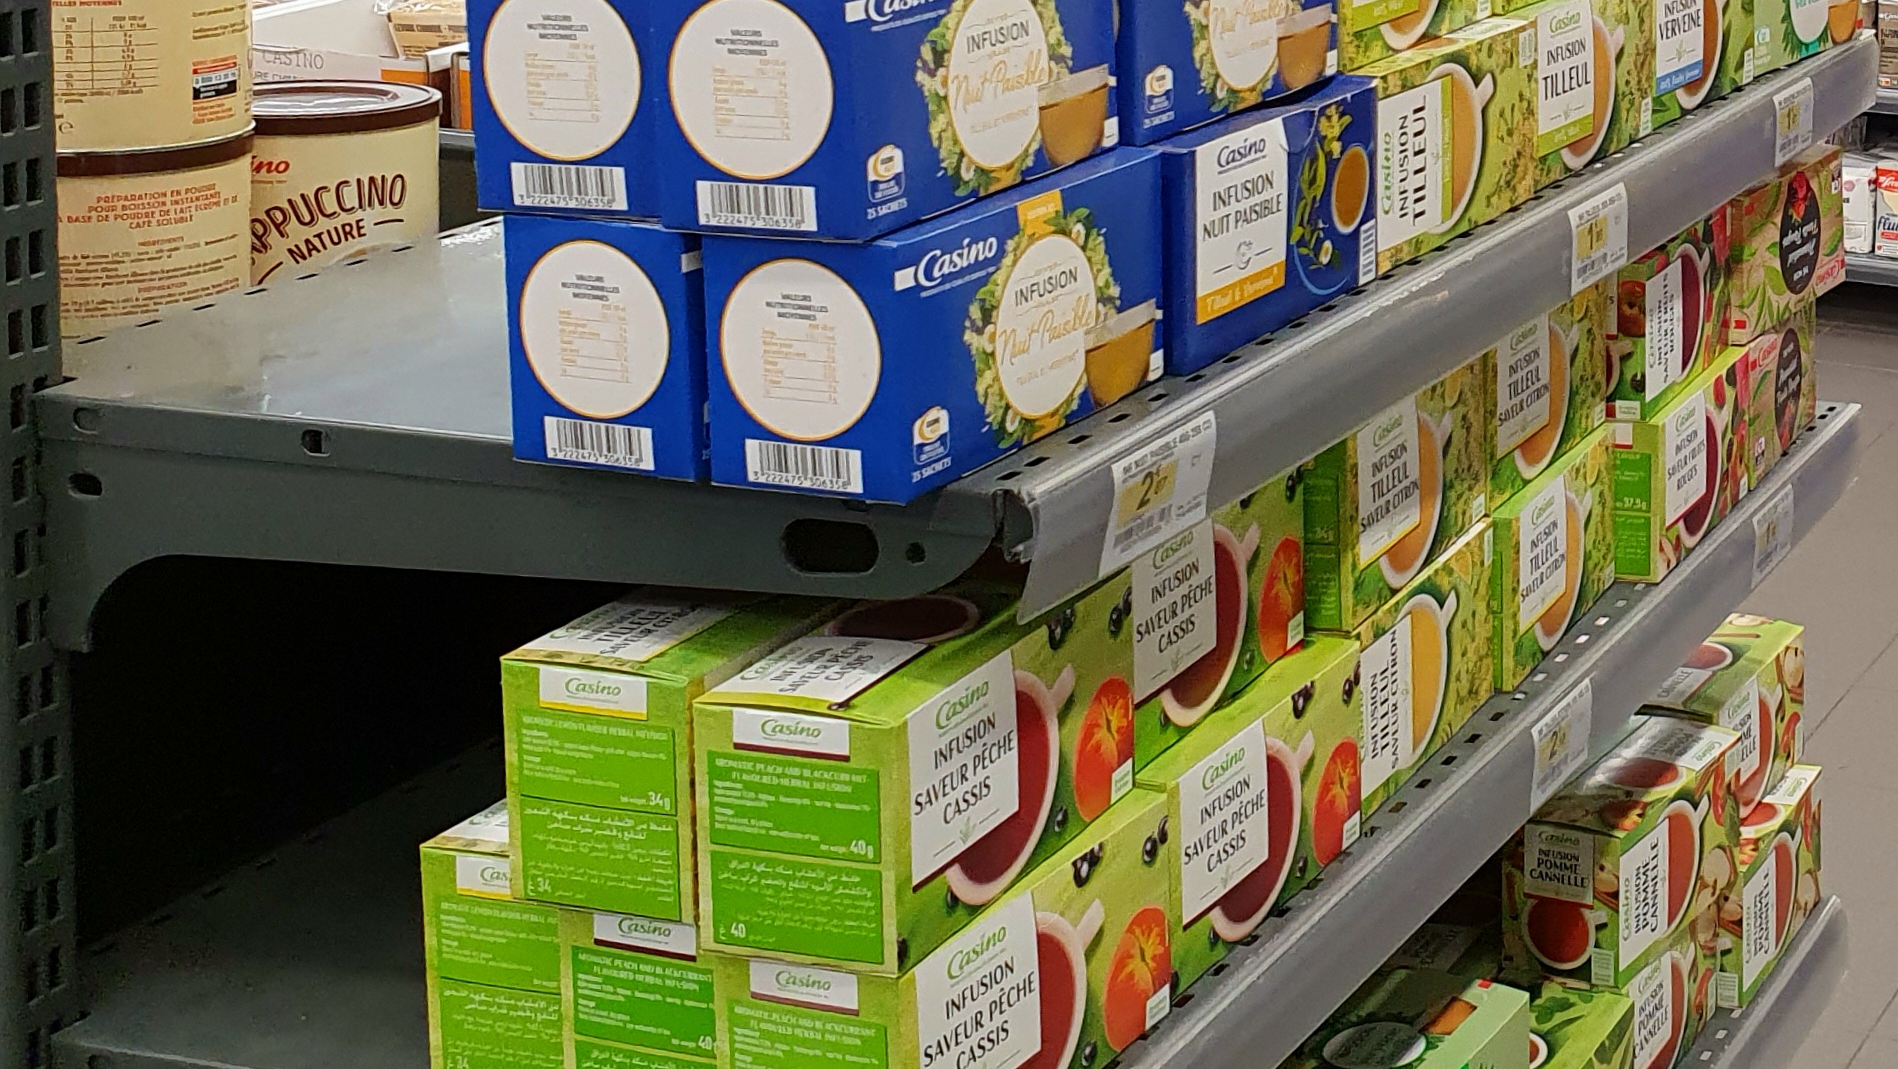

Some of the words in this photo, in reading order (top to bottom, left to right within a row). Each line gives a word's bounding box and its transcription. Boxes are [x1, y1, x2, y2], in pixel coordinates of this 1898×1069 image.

[966, 20, 1030, 54] INFUSION
[1658, 8, 1702, 42] VERVEINE
[262, 52, 325, 71] CASINO
[1546, 36, 1586, 67] INFUSION
[1542, 61, 1591, 102] TILLEUL
[1216, 137, 1266, 168] Casino
[1398, 114, 1410, 220] INFUSION
[1412, 94, 1428, 227] TILLEUL
[88, 202, 118, 214] POUR
[121, 198, 167, 213] BOISSON
[530, 195, 570, 207] 222475
[1212, 170, 1275, 212] INFUSION
[1202, 212, 1232, 243] NUIT
[1234, 192, 1284, 230] PAISIBLE
[286, 217, 367, 265] NATURE
[917, 237, 998, 287] Casino
[1014, 266, 1078, 307] INFUSION
[1507, 365, 1542, 402] TILLEUL
[1508, 346, 1541, 379] INFUSION
[562, 448, 599, 462] 222475
[765, 471, 803, 485] 222475
[1370, 465, 1410, 504] TILLEUL
[1360, 497, 1393, 534] SAVEUR
[1393, 480, 1420, 512] CITRON
[1153, 531, 1194, 570] Casino
[1151, 557, 1200, 606] INFUSION
[1136, 604, 1178, 644] SAVEUR
[1180, 575, 1214, 618] PÊCHE
[1157, 613, 1196, 655] CASSIS
[1390, 628, 1399, 697] CITRON
[564, 676, 622, 698] Casino
[1379, 659, 1391, 758] TILLEUL
[760, 717, 822, 740] Casino
[1370, 673, 1379, 760] INFUSION
[1391, 698, 1400, 770] SAVEUR
[933, 711, 997, 771] INFUSION
[913, 758, 969, 817] SAVEUR
[970, 729, 1016, 783] PÊCHE
[1201, 744, 1246, 790] Casino
[943, 780, 992, 827] CASSIS
[1200, 773, 1252, 826] INFUSION
[1183, 819, 1230, 865] SAVEUR
[1229, 787, 1267, 836] PÊCHE
[849, 839, 874, 860] 40g
[1206, 828, 1248, 874] CASSIS
[1536, 858, 1582, 875] POMME
[1537, 847, 1580, 863] INFUSION
[1529, 867, 1589, 889] CANNELLE
[1642, 857, 1651, 932] POMME
[1650, 836, 1660, 934] CANNELLE
[618, 915, 672, 939] Casino
[946, 924, 1007, 982] Casino
[775, 969, 832, 993] Casino
[944, 955, 1016, 1020] INFUSION
[923, 1008, 984, 1069] SAVEUR
[985, 971, 1037, 1029] PÊCHE
[1633, 1005, 1670, 1060] CANNELLE
[1638, 997, 1665, 1037] POMME
[955, 1019, 1011, 1069] CASSIS
